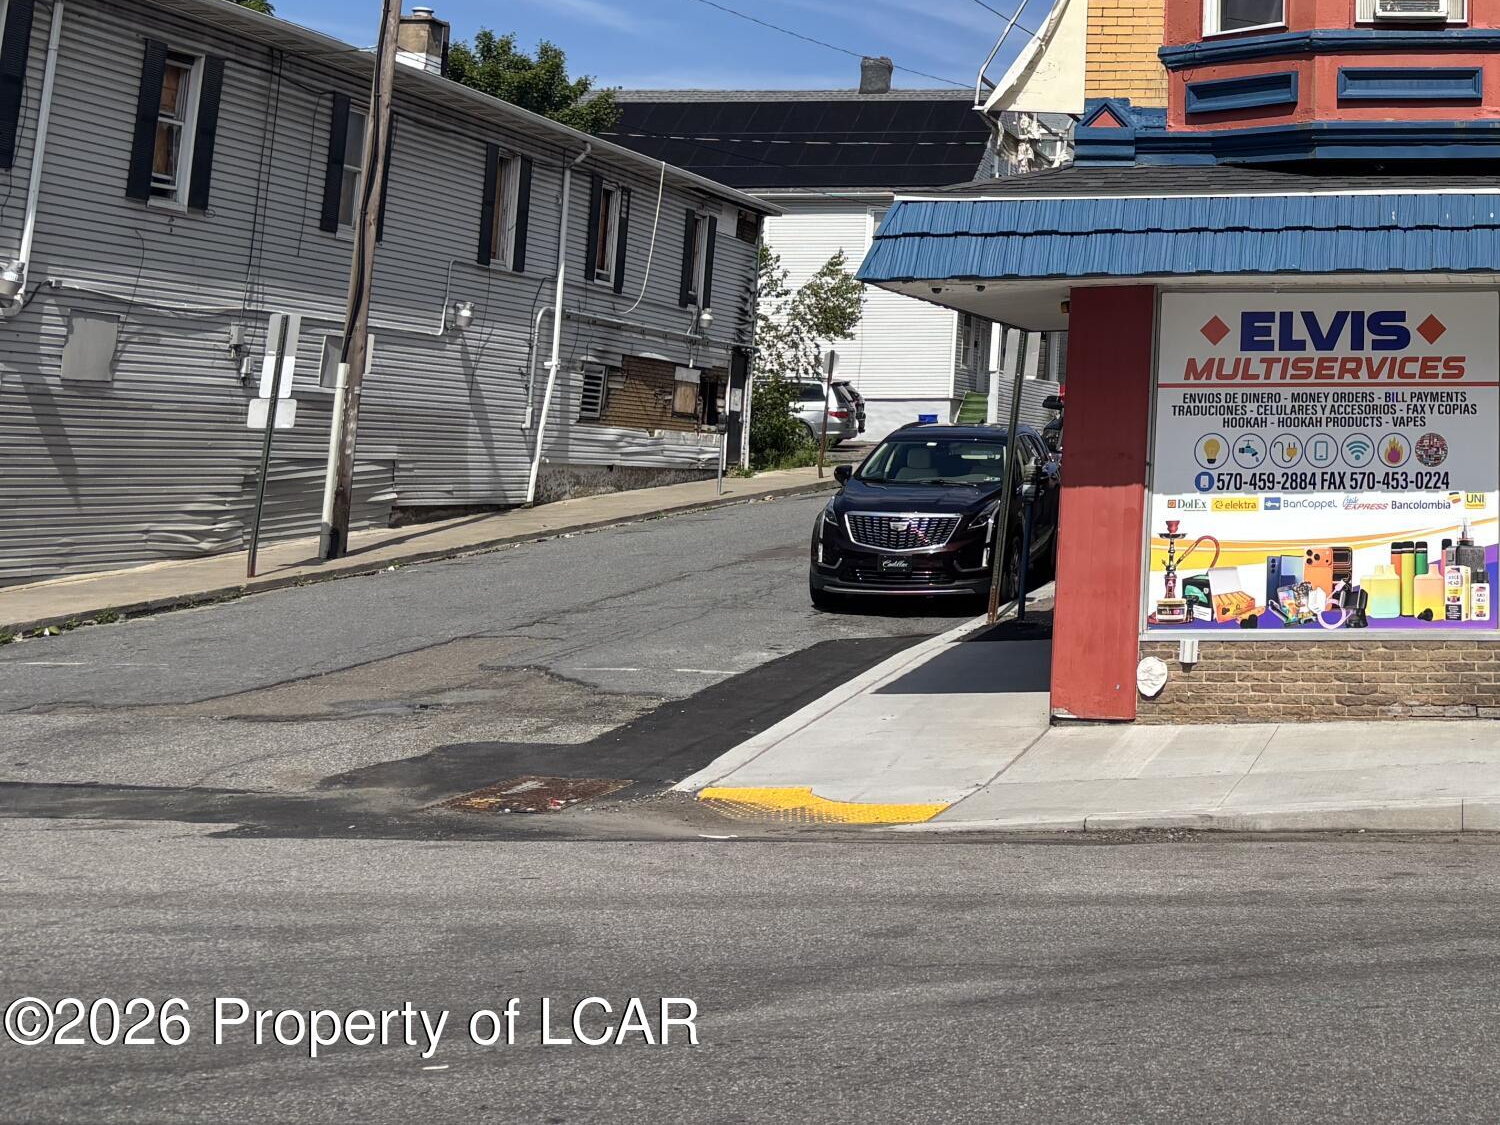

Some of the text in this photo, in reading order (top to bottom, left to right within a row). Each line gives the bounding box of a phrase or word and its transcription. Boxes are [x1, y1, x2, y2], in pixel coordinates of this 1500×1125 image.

[1240, 310, 1411, 351] ELVIS
[1183, 356, 1466, 381] MULTISERVICES
[1182, 392, 1222, 404] ENVIOS
[1224, 392, 1238, 404] DE
[1241, 392, 1281, 404] DINERO
[1291, 392, 1330, 404] MONEY
[1332, 392, 1375, 403] ORDERS
[1384, 391, 1407, 403] BILL
[1410, 391, 1467, 403] PAYMENTS
[1172, 404, 1247, 416] TRADUCIONES
[1256, 404, 1317, 416] CELULARES
[1320, 404, 1328, 415] Y
[1329, 404, 1397, 415] ACCESORIOS
[1406, 403, 1426, 415] FAX
[1428, 403, 1436, 415] Y
[1437, 403, 1477, 415] COPIAS
[1222, 417, 1268, 428] HOOKAH
[1277, 416, 1323, 428] HOOKAH
[1325, 416, 1383, 427] PRODUCTS
[1392, 416, 1426, 427] VAPES
[1216, 471, 1450, 491] 570-459-2884 FAX 570-453-0224
[1224, 500, 1257, 510] elektra
[1391, 500, 1451, 510] Bancolombia
